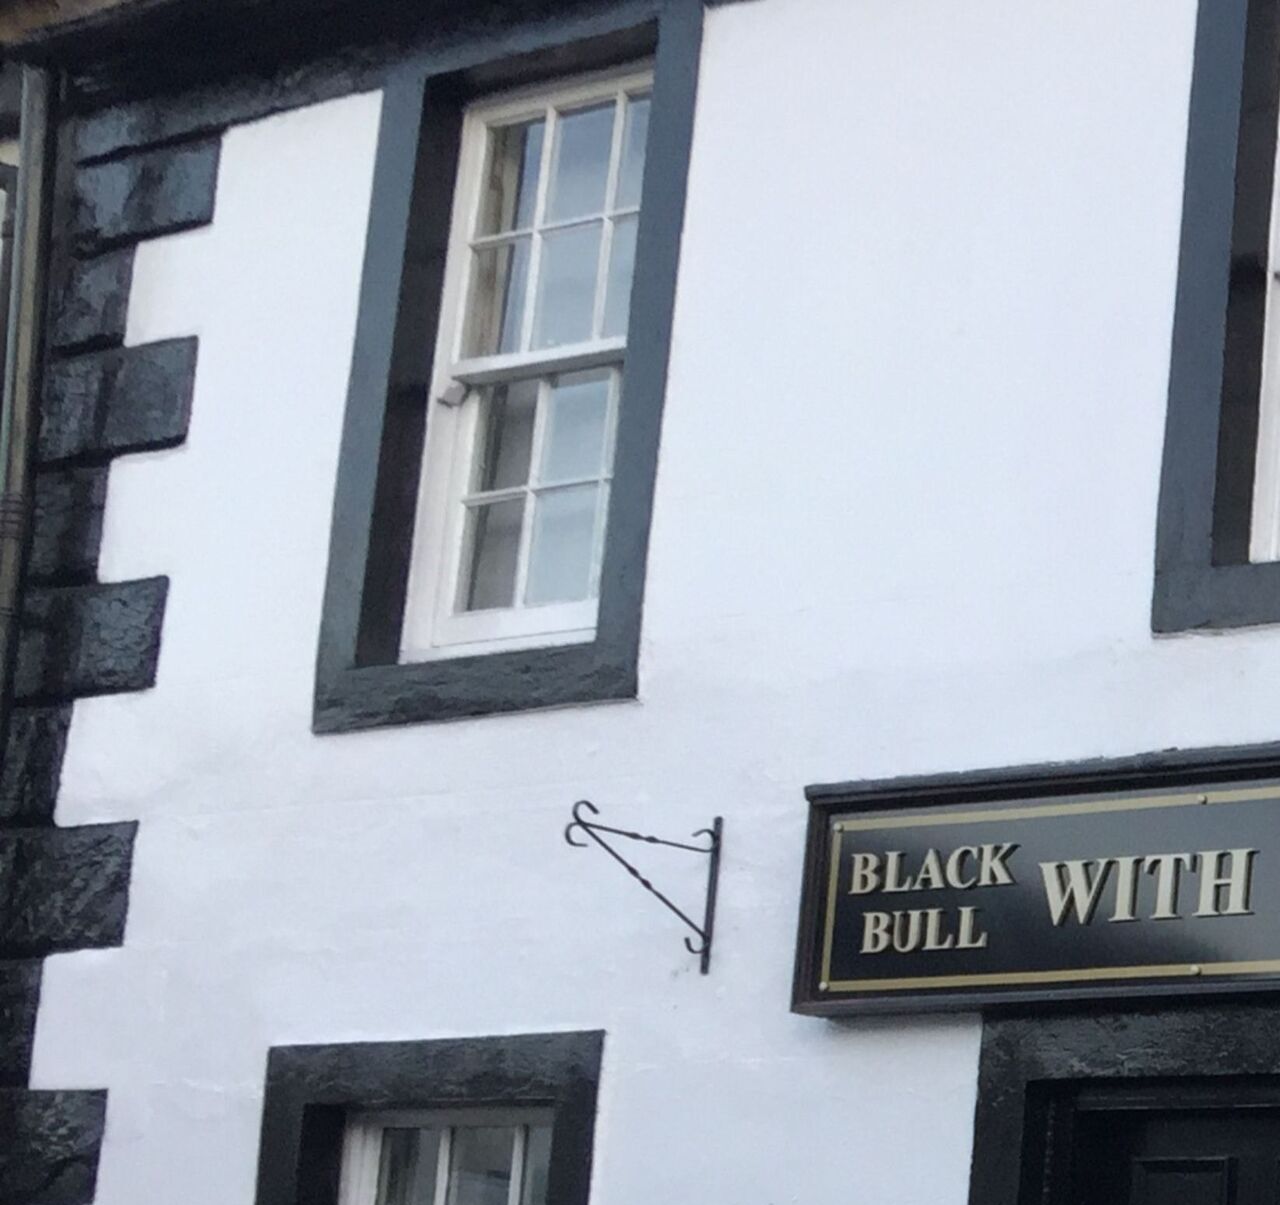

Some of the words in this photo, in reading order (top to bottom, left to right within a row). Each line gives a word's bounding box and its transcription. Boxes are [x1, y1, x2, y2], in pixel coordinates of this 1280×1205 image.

[848, 842, 1015, 896] BLACK
[1038, 846, 1256, 928] WITH
[859, 906, 988, 955] BULL
